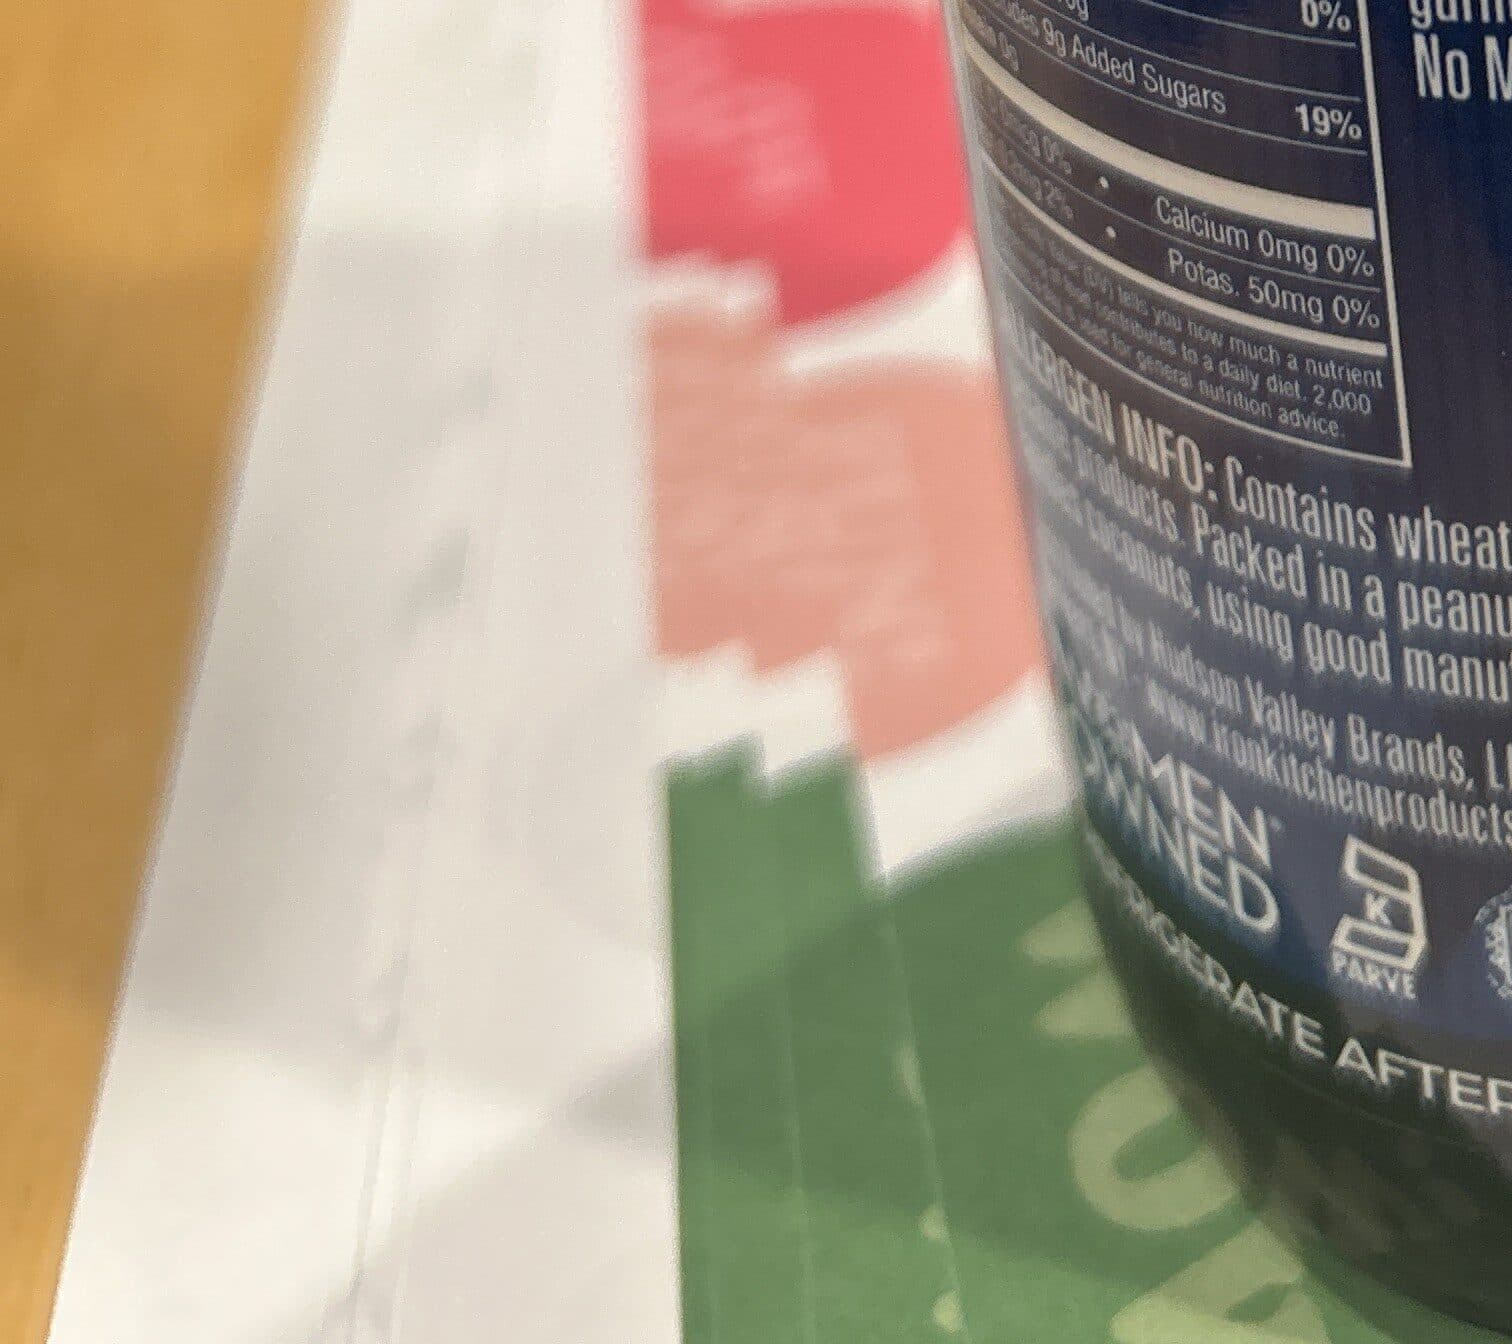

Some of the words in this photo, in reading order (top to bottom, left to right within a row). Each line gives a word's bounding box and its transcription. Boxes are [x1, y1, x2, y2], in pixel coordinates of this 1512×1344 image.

[1043, 17, 1066, 58] 9g
[1071, 31, 1137, 84] Added
[1142, 63, 1228, 116] Sugars
[1295, 103, 1364, 141] 19%
[1412, 33, 1472, 101] No
[1156, 195, 1250, 252] Calcium
[1257, 231, 1319, 272] 0mg
[1327, 244, 1375, 279] 0%
[1168, 248, 1240, 299] Potas.
[1249, 275, 1323, 323] 50mg
[1332, 295, 1380, 329] 0%
[1199, 377, 1272, 420] nutrition
[1277, 407, 1345, 439] advice.
[1203, 353, 1215, 373] a
[1218, 357, 1260, 394] daily
[1311, 384, 1372, 414] 2,000
[1230, 334, 1281, 366] much
[1287, 354, 1298, 372] a
[1305, 360, 1383, 390] nutrient
[1120, 402, 1219, 501] INFO:
[1224, 455, 1377, 553] Contains
[1191, 501, 1307, 601] Packed
[1318, 549, 1351, 613] in
[1364, 574, 1386, 619] a
[1206, 580, 1295, 664] using
[1303, 620, 1391, 685] good
[1243, 673, 1336, 764] Valley
[1347, 713, 1475, 795] Brands,
[1081, 737, 1280, 933] WNED
[1084, 822, 1327, 1060] RIGERATE
[1364, 891, 1392, 926] K
